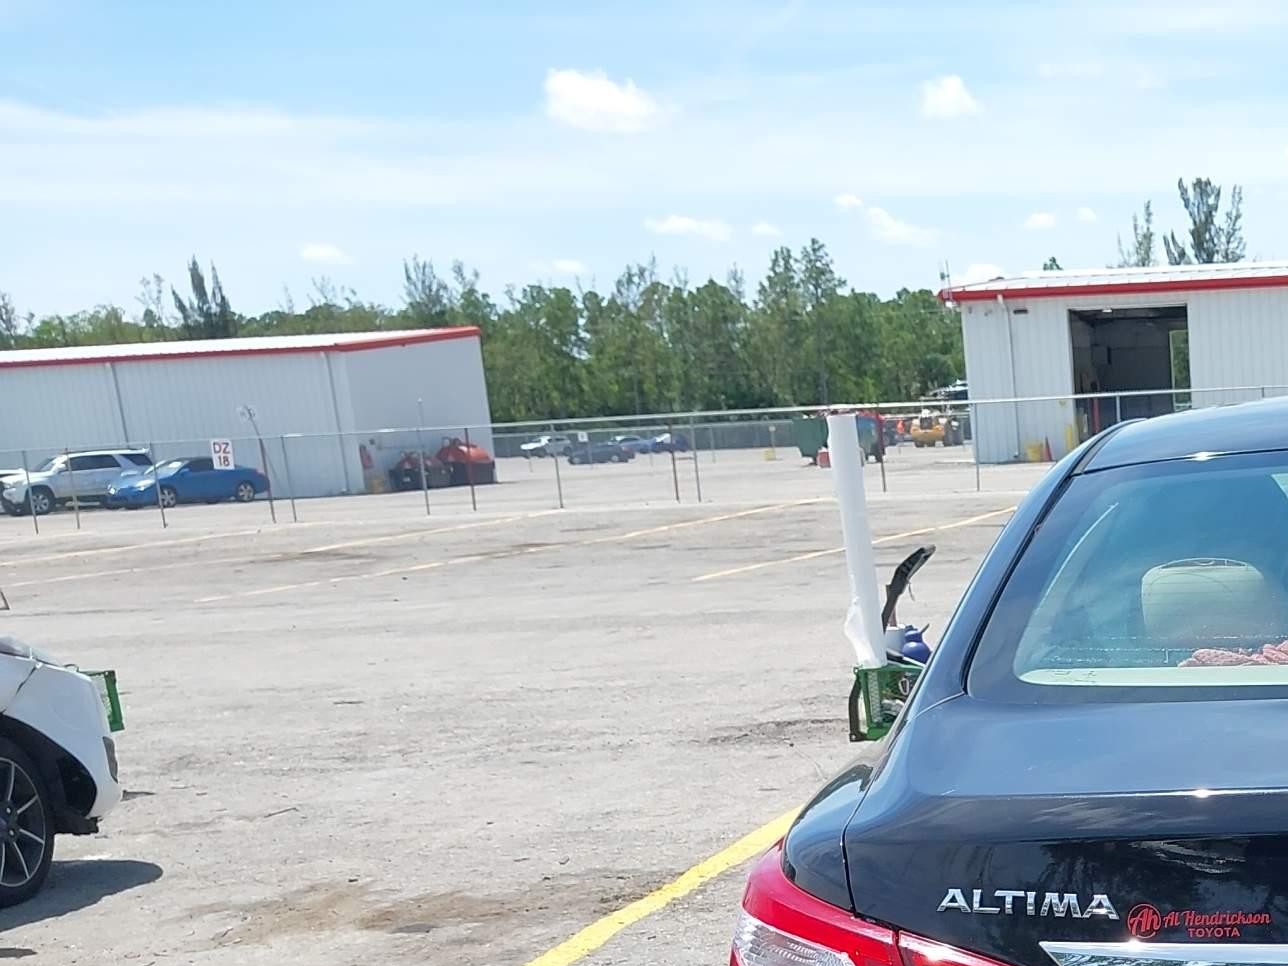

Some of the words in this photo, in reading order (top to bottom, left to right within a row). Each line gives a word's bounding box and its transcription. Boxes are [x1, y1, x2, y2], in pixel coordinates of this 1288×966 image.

[213, 442, 230, 454] DZ
[218, 456, 230, 467] 18
[936, 888, 1120, 920] ALTIMA
[1163, 911, 1180, 928] Al
[1181, 911, 1271, 926] Hendrickson
[1188, 928, 1240, 937] TOYOTA
